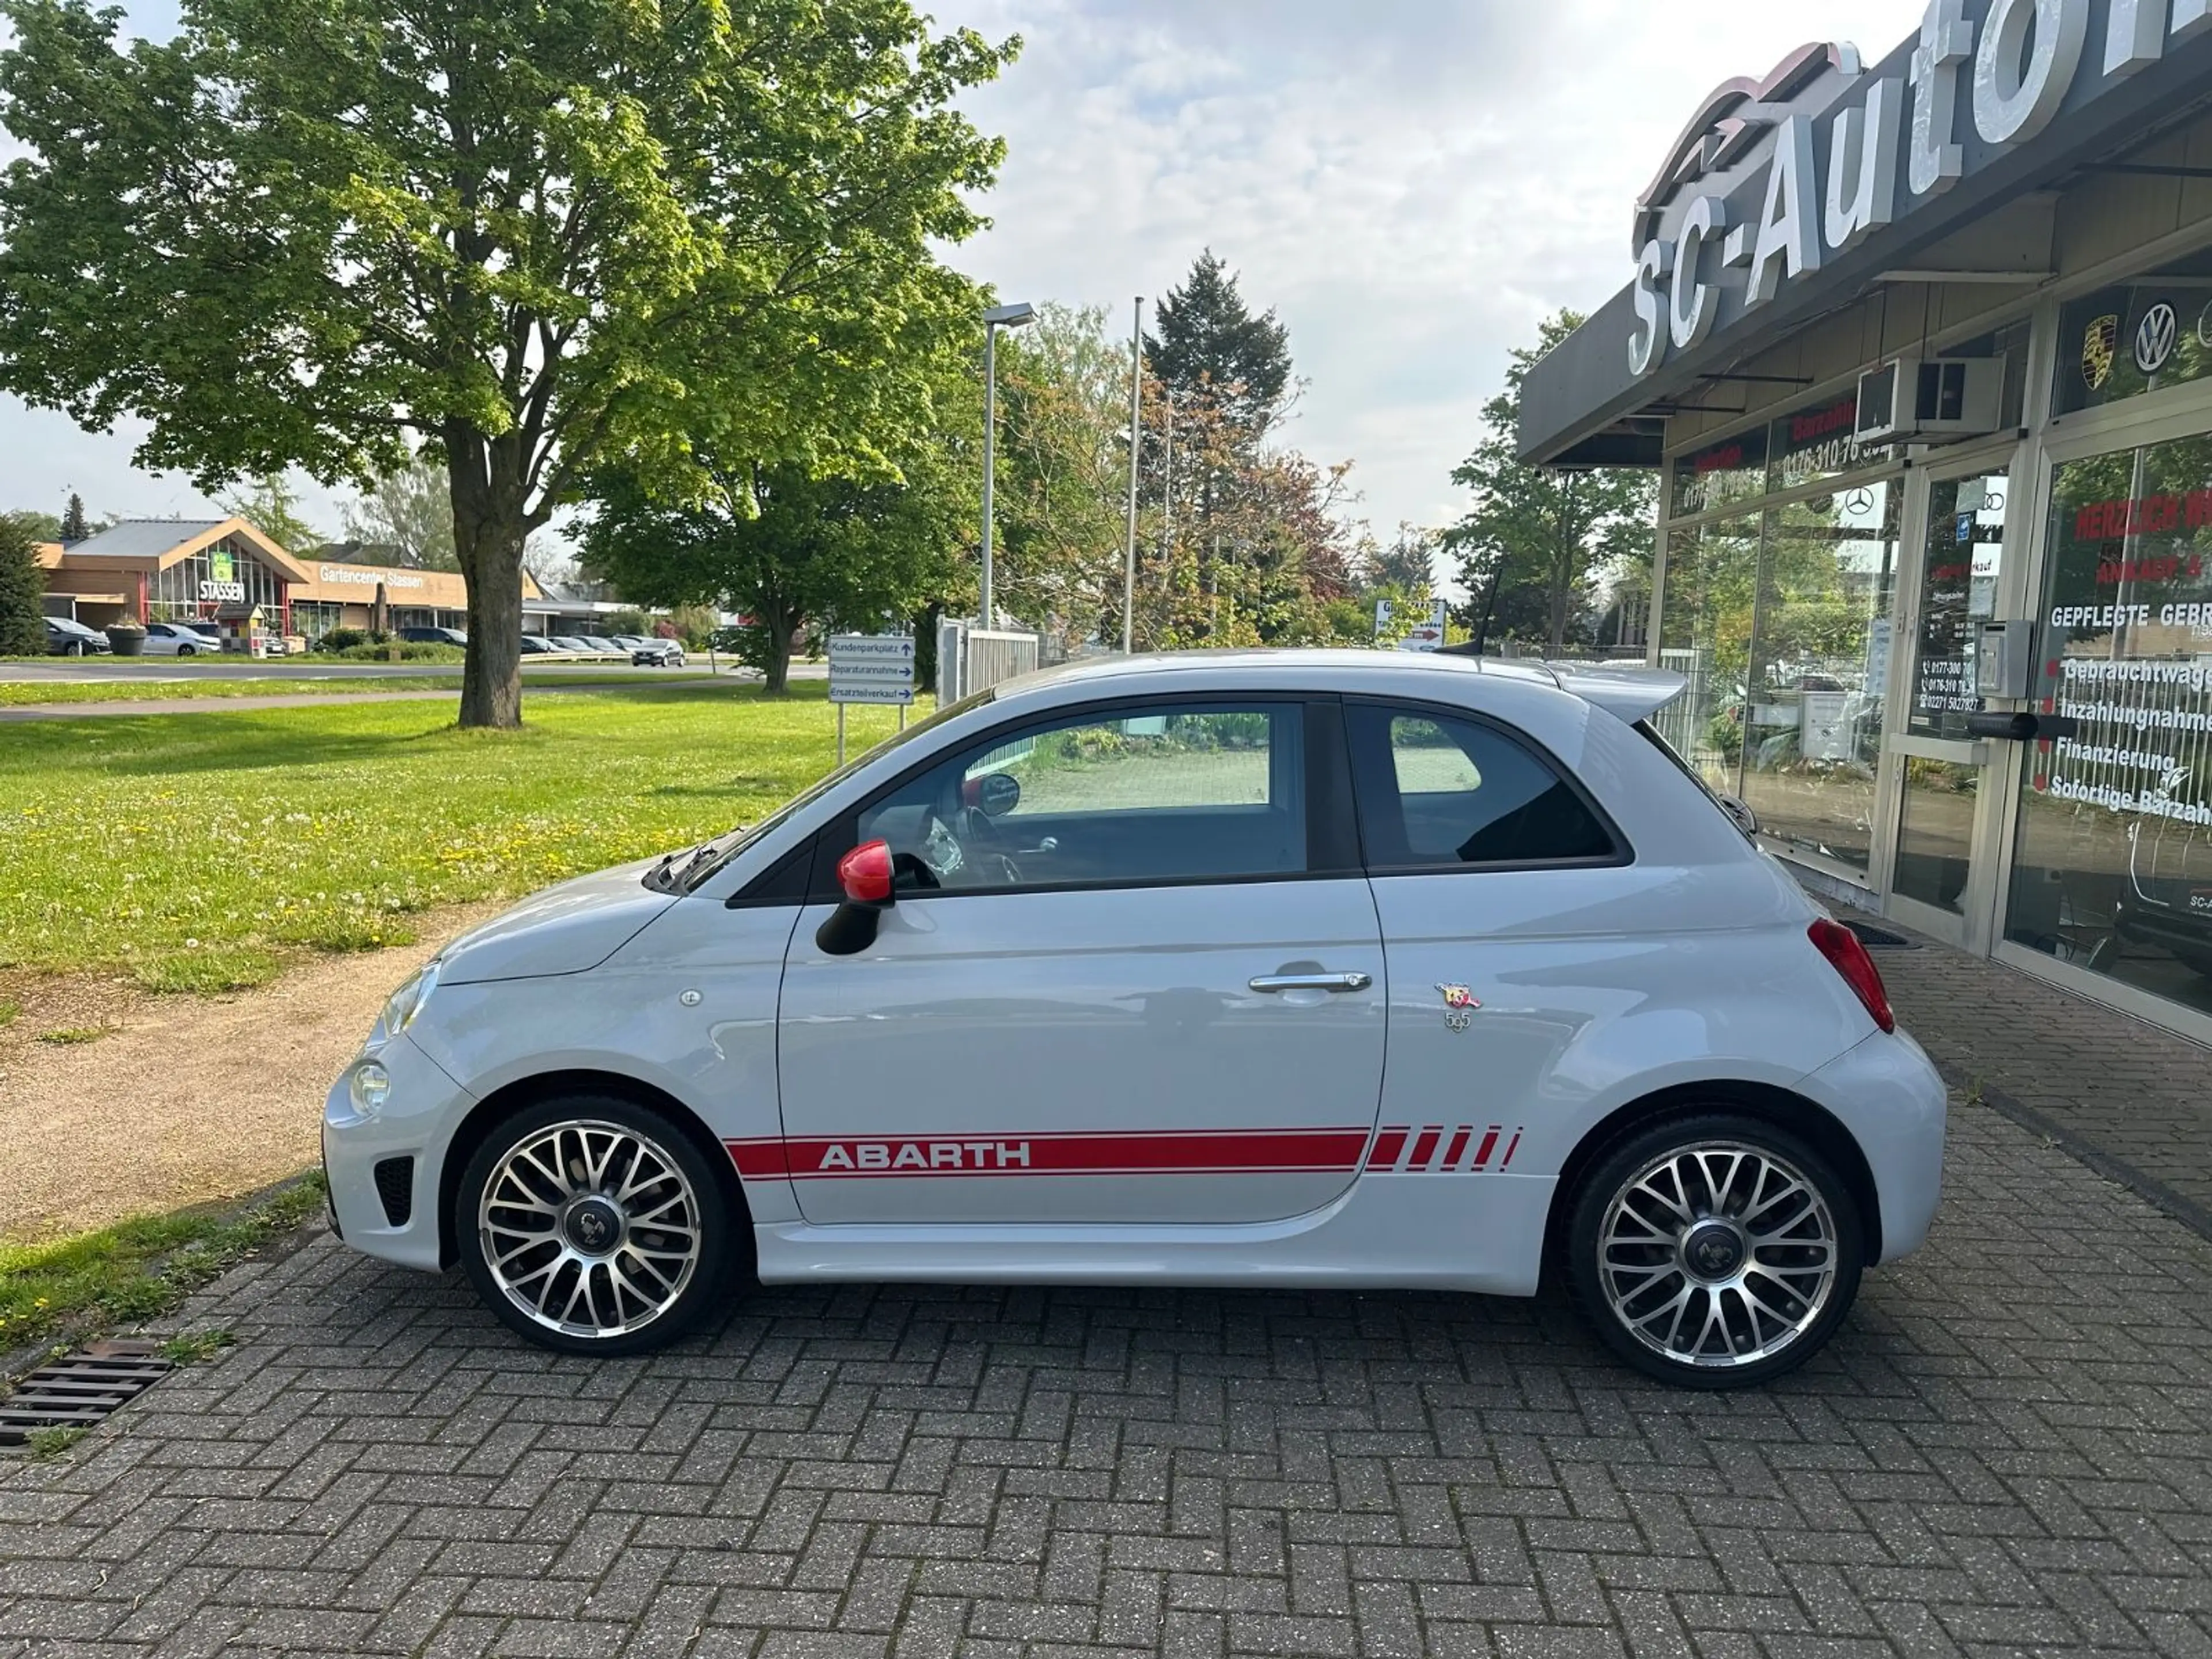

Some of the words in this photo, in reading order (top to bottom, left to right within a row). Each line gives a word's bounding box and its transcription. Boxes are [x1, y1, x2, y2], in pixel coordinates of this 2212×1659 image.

[1783, 438, 1839, 474] 0176-310
[320, 565, 385, 584] Gartencenter
[387, 571, 423, 588] Stassen
[200, 581, 245, 601] STASSEN
[2051, 604, 2150, 627] GEPFLEGTE
[2056, 736, 2176, 778] Finanzierung
[2051, 775, 2133, 812] Sofortige
[2139, 789, 2212, 826] Barzah
[1445, 1012, 1471, 1033] 595
[818, 1142, 1030, 1169] ABARTH
